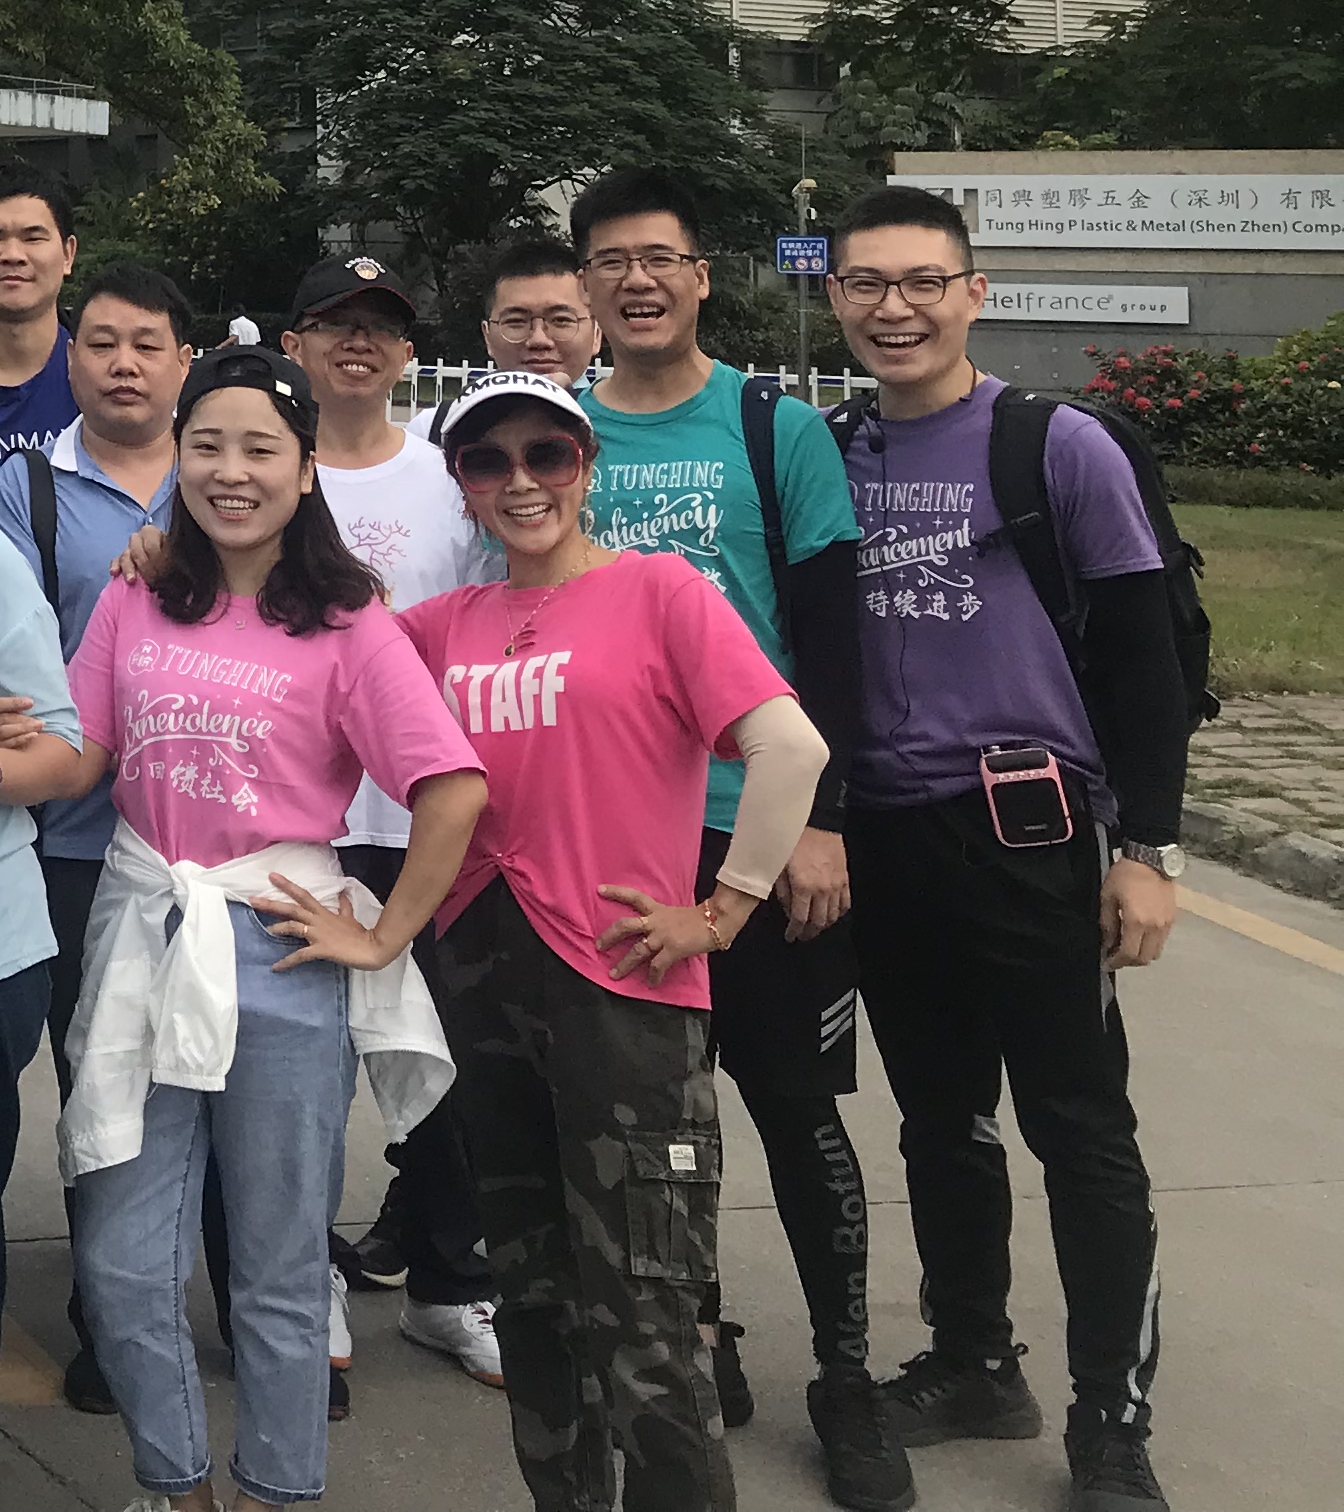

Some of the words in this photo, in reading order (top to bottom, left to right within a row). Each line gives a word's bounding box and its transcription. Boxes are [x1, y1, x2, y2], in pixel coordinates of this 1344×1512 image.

[986, 219, 1024, 233] Tung
[1028, 219, 1064, 234] Hing
[1126, 219, 1138, 232] &
[1141, 219, 1187, 233] Metal
[1189, 219, 1237, 234] (Shen
[1240, 220, 1288, 235] Zhen)
[1120, 301, 1168, 313] group
[607, 460, 724, 491] TUNGHING
[864, 481, 975, 513] TUNGHING
[866, 589, 983, 622] 持续进步
[161, 644, 293, 704] TUNGHING
